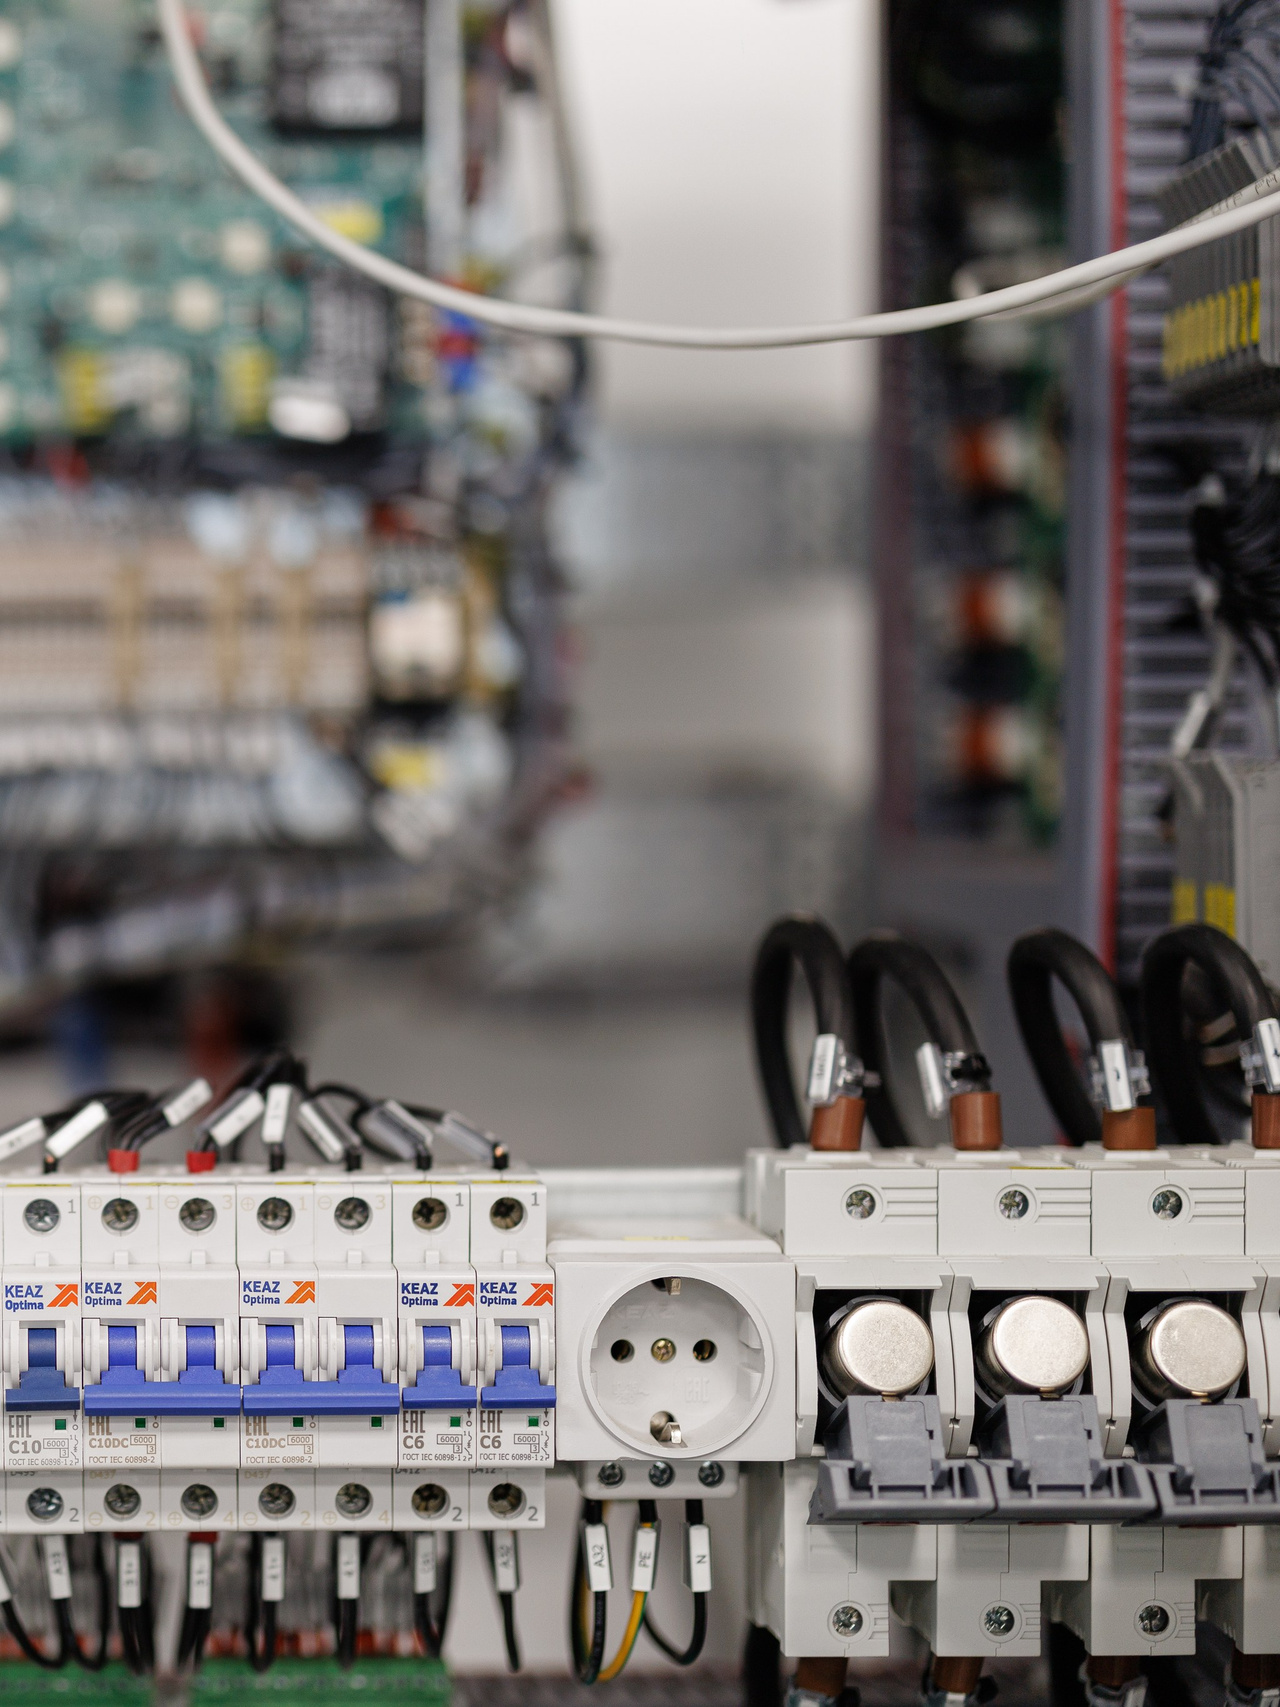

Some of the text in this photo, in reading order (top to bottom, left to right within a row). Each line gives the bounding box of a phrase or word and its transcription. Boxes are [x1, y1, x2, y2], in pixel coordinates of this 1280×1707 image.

[146, 1196, 154, 1210] 1
[222, 1195, 232, 1210] 3
[299, 1196, 308, 1210] 1
[375, 1194, 386, 1209] 3
[456, 1192, 464, 1206] 1
[531, 1192, 540, 1206] 1
[68, 1200, 76, 1214] 1
[5, 1285, 44, 1298] KEAZ
[84, 1282, 122, 1295] KEAZ
[243, 1281, 280, 1293] KEAZ
[401, 1283, 438, 1294] KEAZ
[480, 1282, 518, 1294] KEAZ
[5, 1300, 44, 1312] Optima
[84, 1296, 122, 1307] Optima
[243, 1295, 280, 1306] Optima
[401, 1296, 438, 1307] Optima
[480, 1295, 518, 1307] Optima
[8, 1415, 32, 1438] EAC
[88, 1416, 112, 1436] EAC
[246, 1416, 270, 1436] EAC
[403, 1410, 425, 1433] EAC
[480, 1410, 503, 1433] EAC
[8, 1440, 42, 1454] C10
[88, 1438, 128, 1448] C10DC
[246, 1438, 286, 1448] C10DC
[403, 1435, 424, 1449] C6
[480, 1435, 501, 1449] C6
[9, 1458, 25, 1466] ГОСТ
[41, 1458, 68, 1466] 60898-1
[244, 1470, 270, 1479] D437
[69, 1508, 79, 1522] 2
[146, 1511, 156, 1526] 2
[223, 1511, 234, 1525] 4
[300, 1511, 311, 1525] 2
[378, 1510, 389, 1524] 4
[452, 1507, 462, 1521] 2
[528, 1506, 538, 1521] 2
[592, 1544, 605, 1568] A32
[639, 1551, 650, 1568] PE
[697, 1554, 707, 1564] N
